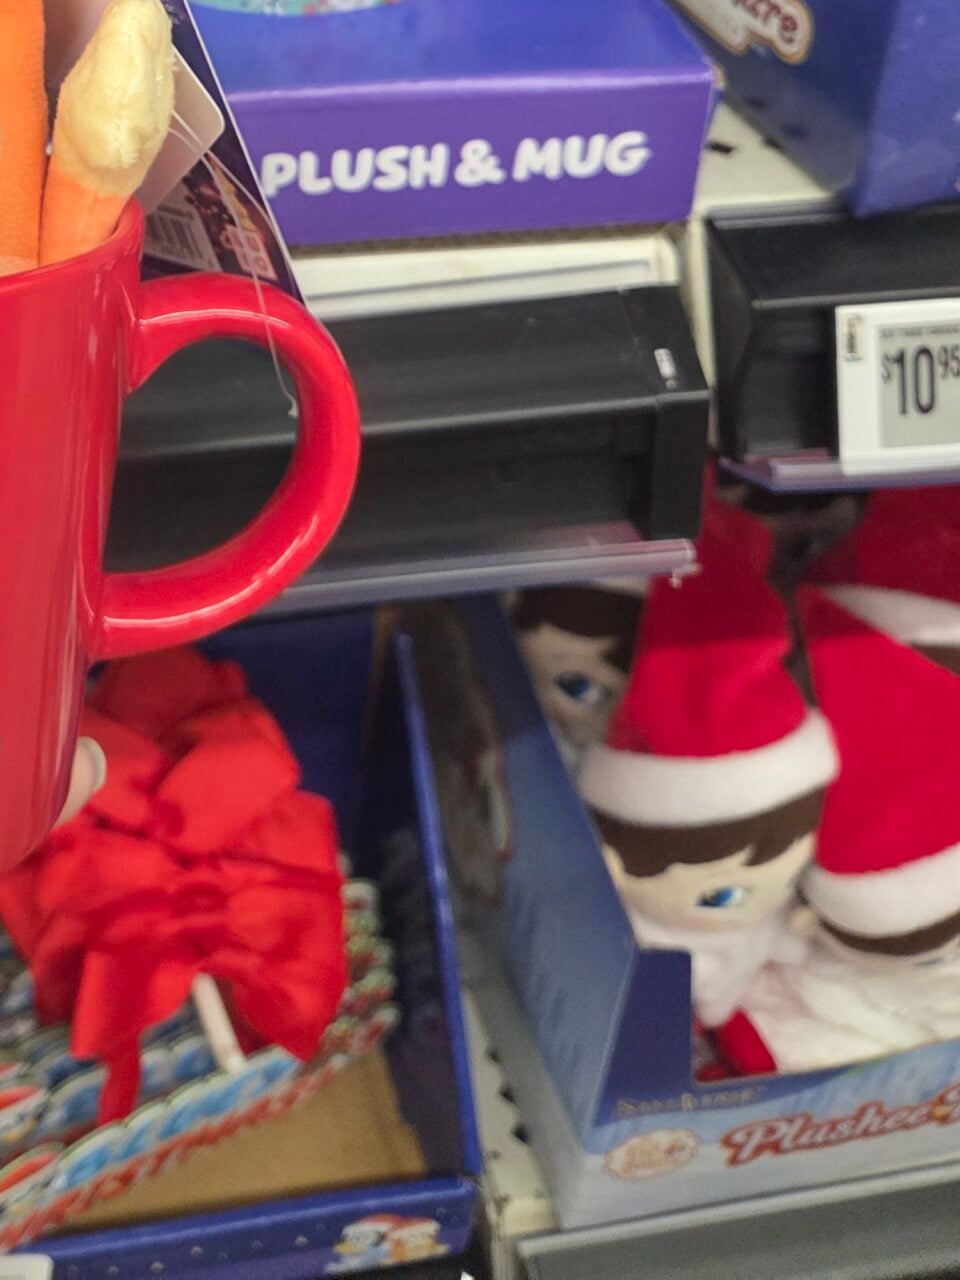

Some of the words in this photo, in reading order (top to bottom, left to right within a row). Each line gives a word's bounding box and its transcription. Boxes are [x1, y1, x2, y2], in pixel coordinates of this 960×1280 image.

[261, 141, 449, 198] PLUSH
[454, 139, 505, 188] &
[512, 130, 651, 184] MUG
